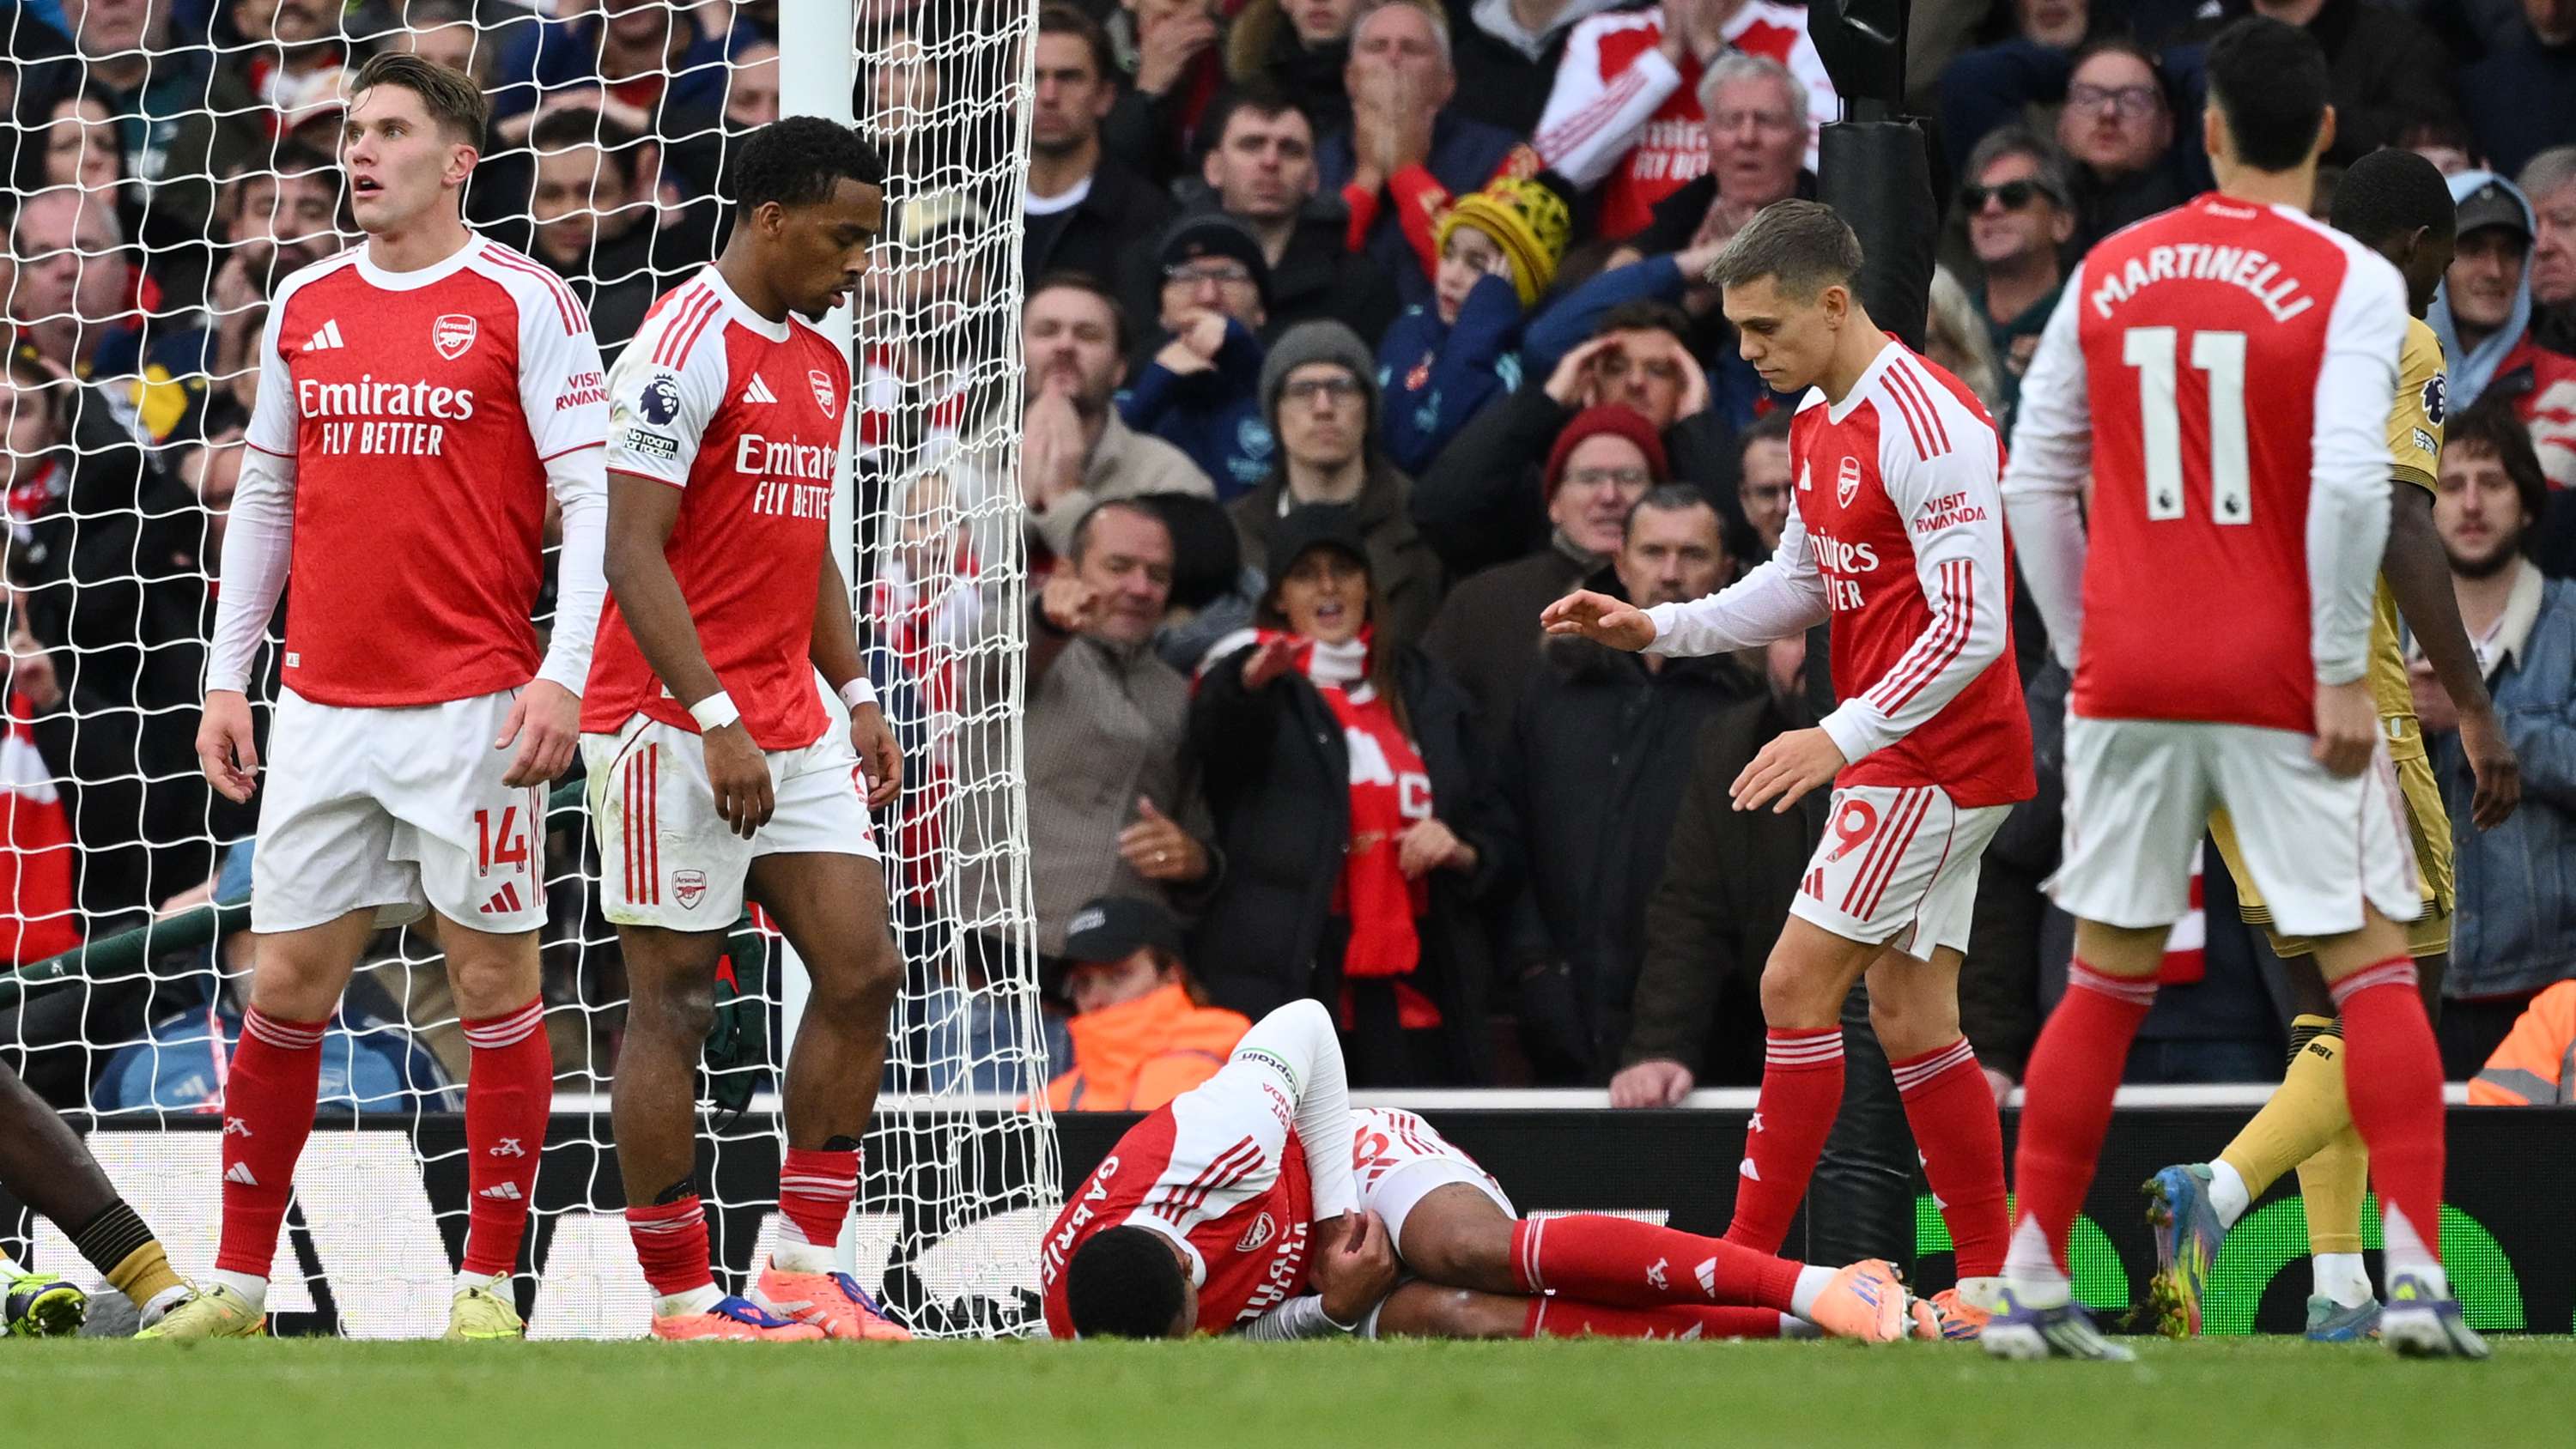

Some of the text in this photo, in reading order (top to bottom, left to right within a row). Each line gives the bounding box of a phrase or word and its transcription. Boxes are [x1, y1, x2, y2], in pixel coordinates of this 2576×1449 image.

[2092, 243, 2314, 322] MARTINELLI
[299, 374, 474, 420] Emirates
[556, 389, 611, 411] RWAND
[323, 422, 443, 456] FLY BETTER
[642, 433, 674, 450] room
[2123, 325, 2252, 525] 11
[736, 433, 838, 481] Emirate
[753, 481, 835, 520] FLY BETTE
[1916, 506, 1987, 534] RWANDA
[1924, 491, 1966, 514] VISIT
[475, 806, 527, 877] 14
[1352, 1125, 1389, 1171] 6
